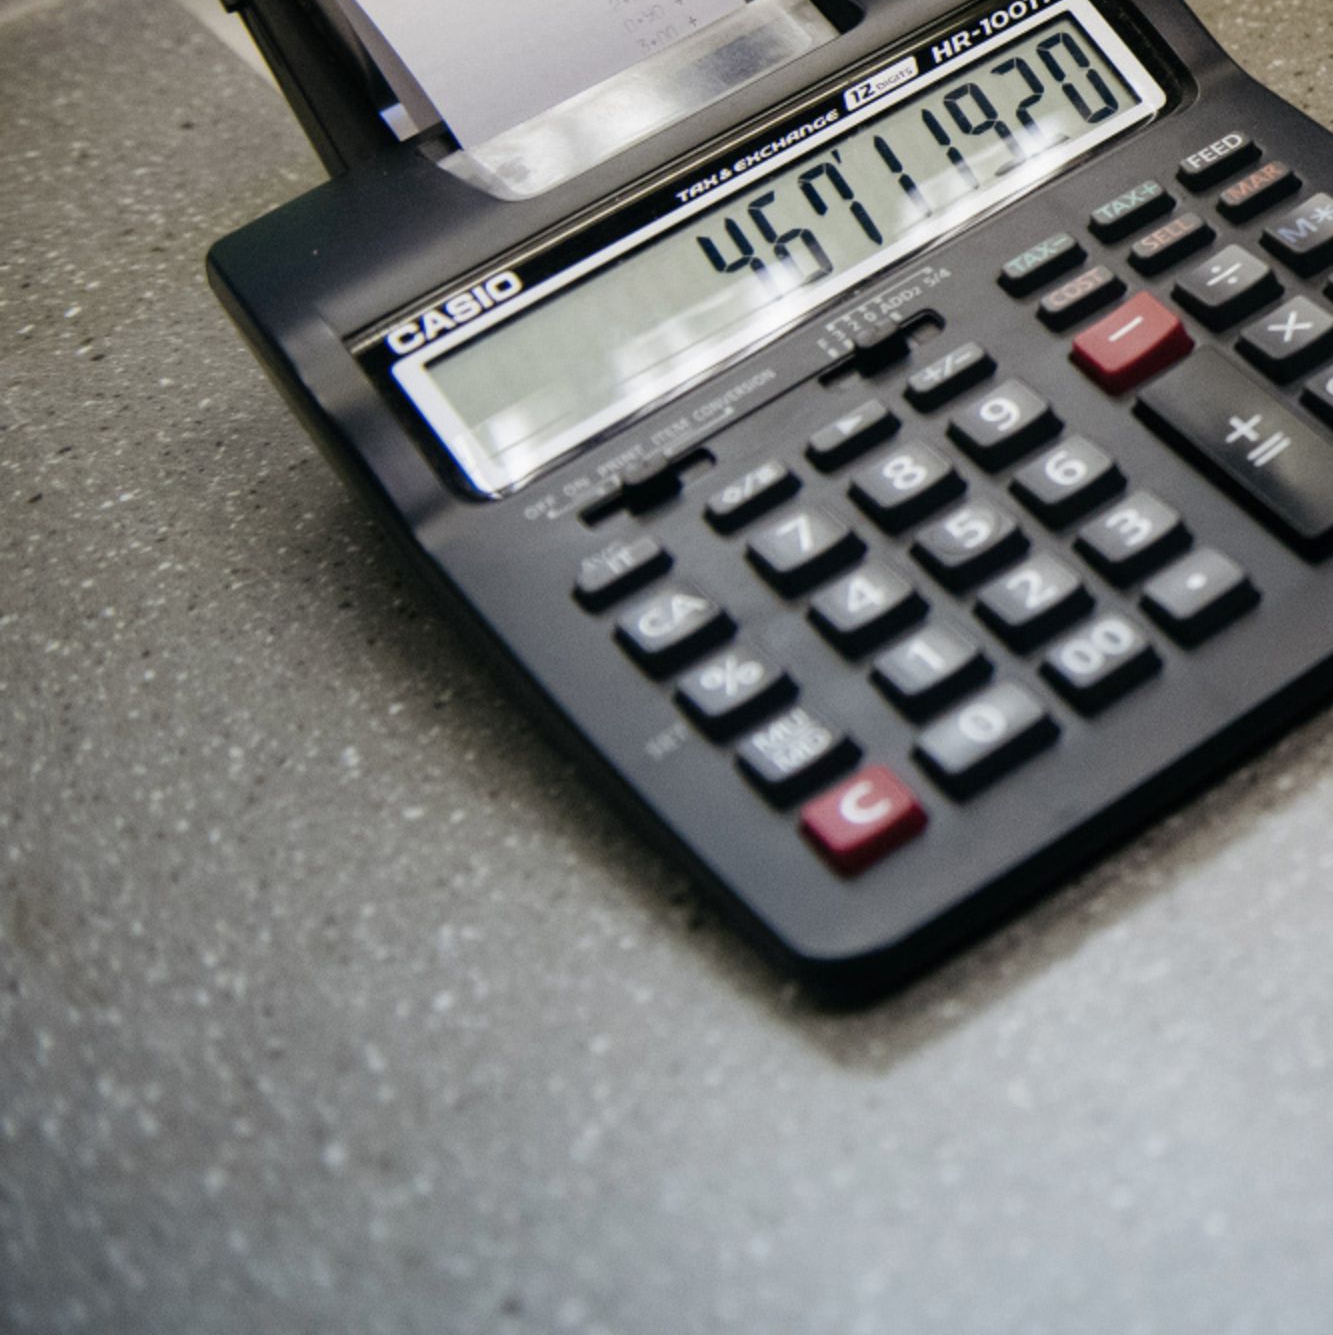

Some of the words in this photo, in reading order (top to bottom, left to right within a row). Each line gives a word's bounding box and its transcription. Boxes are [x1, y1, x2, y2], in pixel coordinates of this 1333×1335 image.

[675, 175, 720, 203] TAX
[732, 108, 841, 174] EXCHANGE
[847, 81, 875, 107] 12
[876, 66, 914, 91] DIGITS
[1186, 133, 1245, 172] FEED
[1095, 180, 1162, 222] TAX+
[1227, 163, 1284, 201] MAR
[1140, 218, 1195, 252] SELL
[1047, 267, 1105, 308] COST
[385, 269, 525, 357] CASIO
[979, 396, 1021, 431] 9
[881, 455, 929, 491] 8
[1045, 450, 1087, 487] 6
[777, 515, 815, 550] 7
[945, 510, 992, 548] 5
[1106, 506, 1153, 546] 3
[845, 576, 887, 613] 4
[1005, 570, 1059, 608] 2
[638, 592, 708, 639] CA
[904, 640, 946, 670] 1
[1060, 618, 1134, 674] 00
[958, 701, 1006, 744] 0
[840, 781, 893, 825] C
